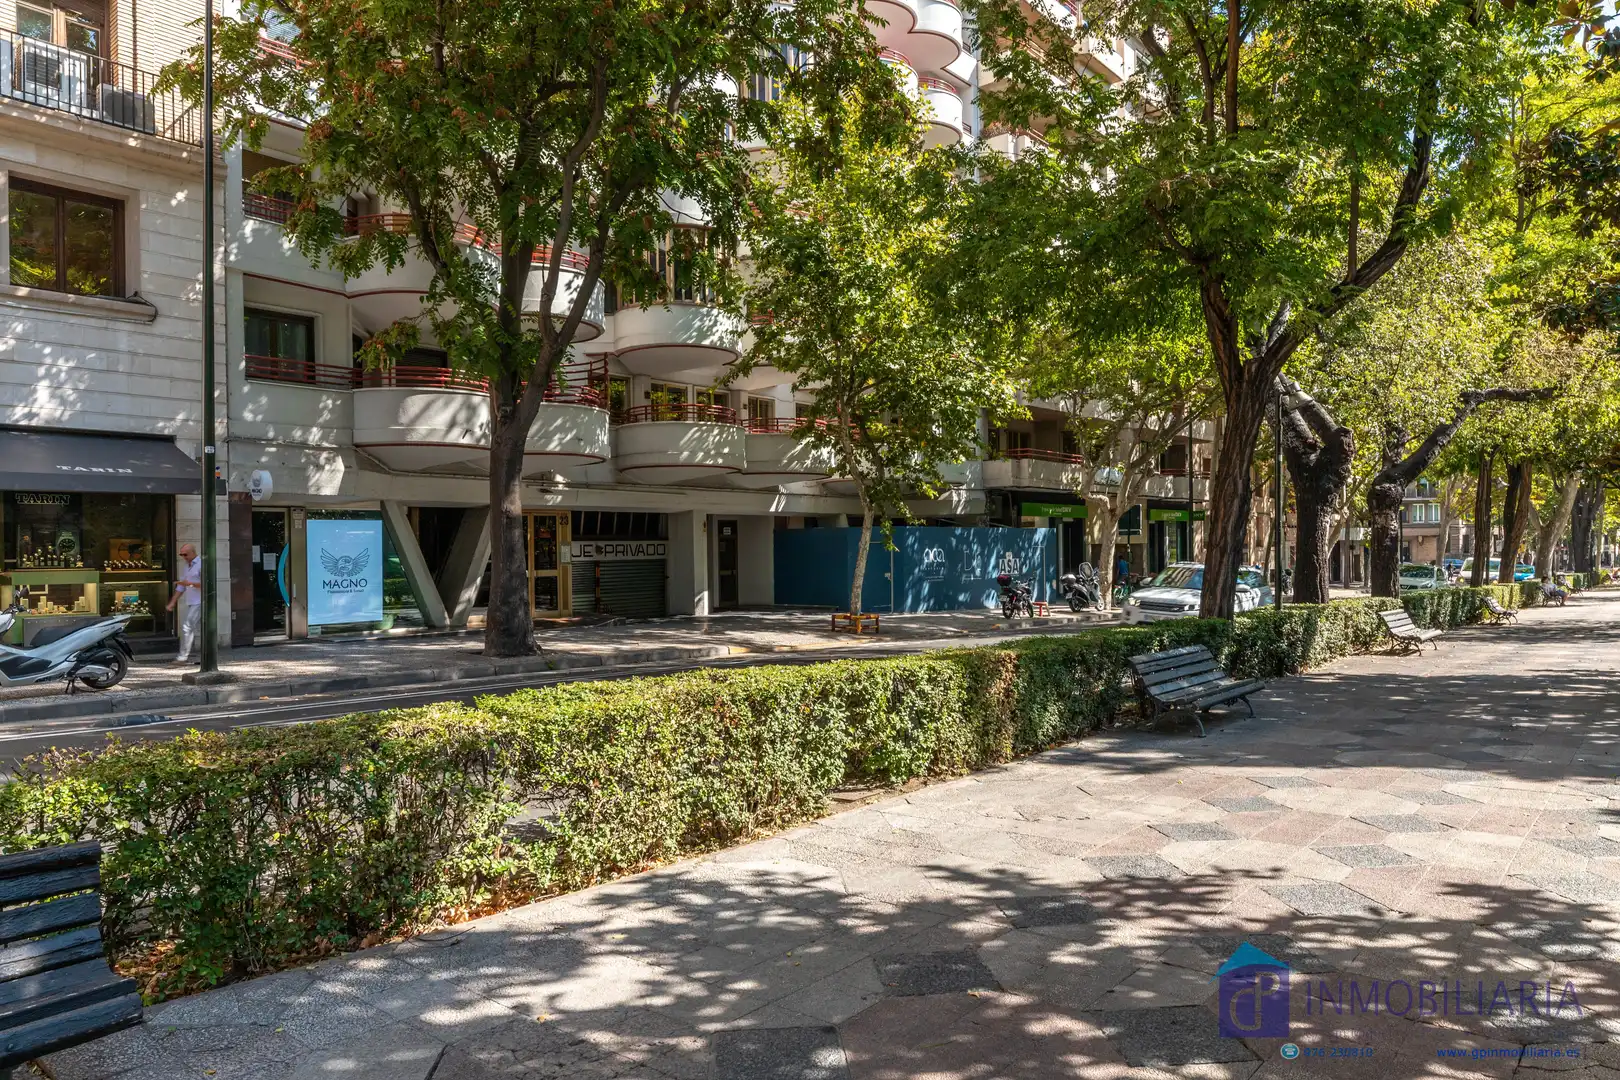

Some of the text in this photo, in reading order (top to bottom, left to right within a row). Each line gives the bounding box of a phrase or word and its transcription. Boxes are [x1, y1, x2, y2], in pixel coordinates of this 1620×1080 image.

[56, 464, 134, 474] TARIN
[15, 492, 71, 506] TARIN
[559, 515, 569, 526] 23
[604, 543, 667, 557] PRIVADO
[1000, 558, 1020, 575] ASA
[322, 578, 368, 589] MAGNO
